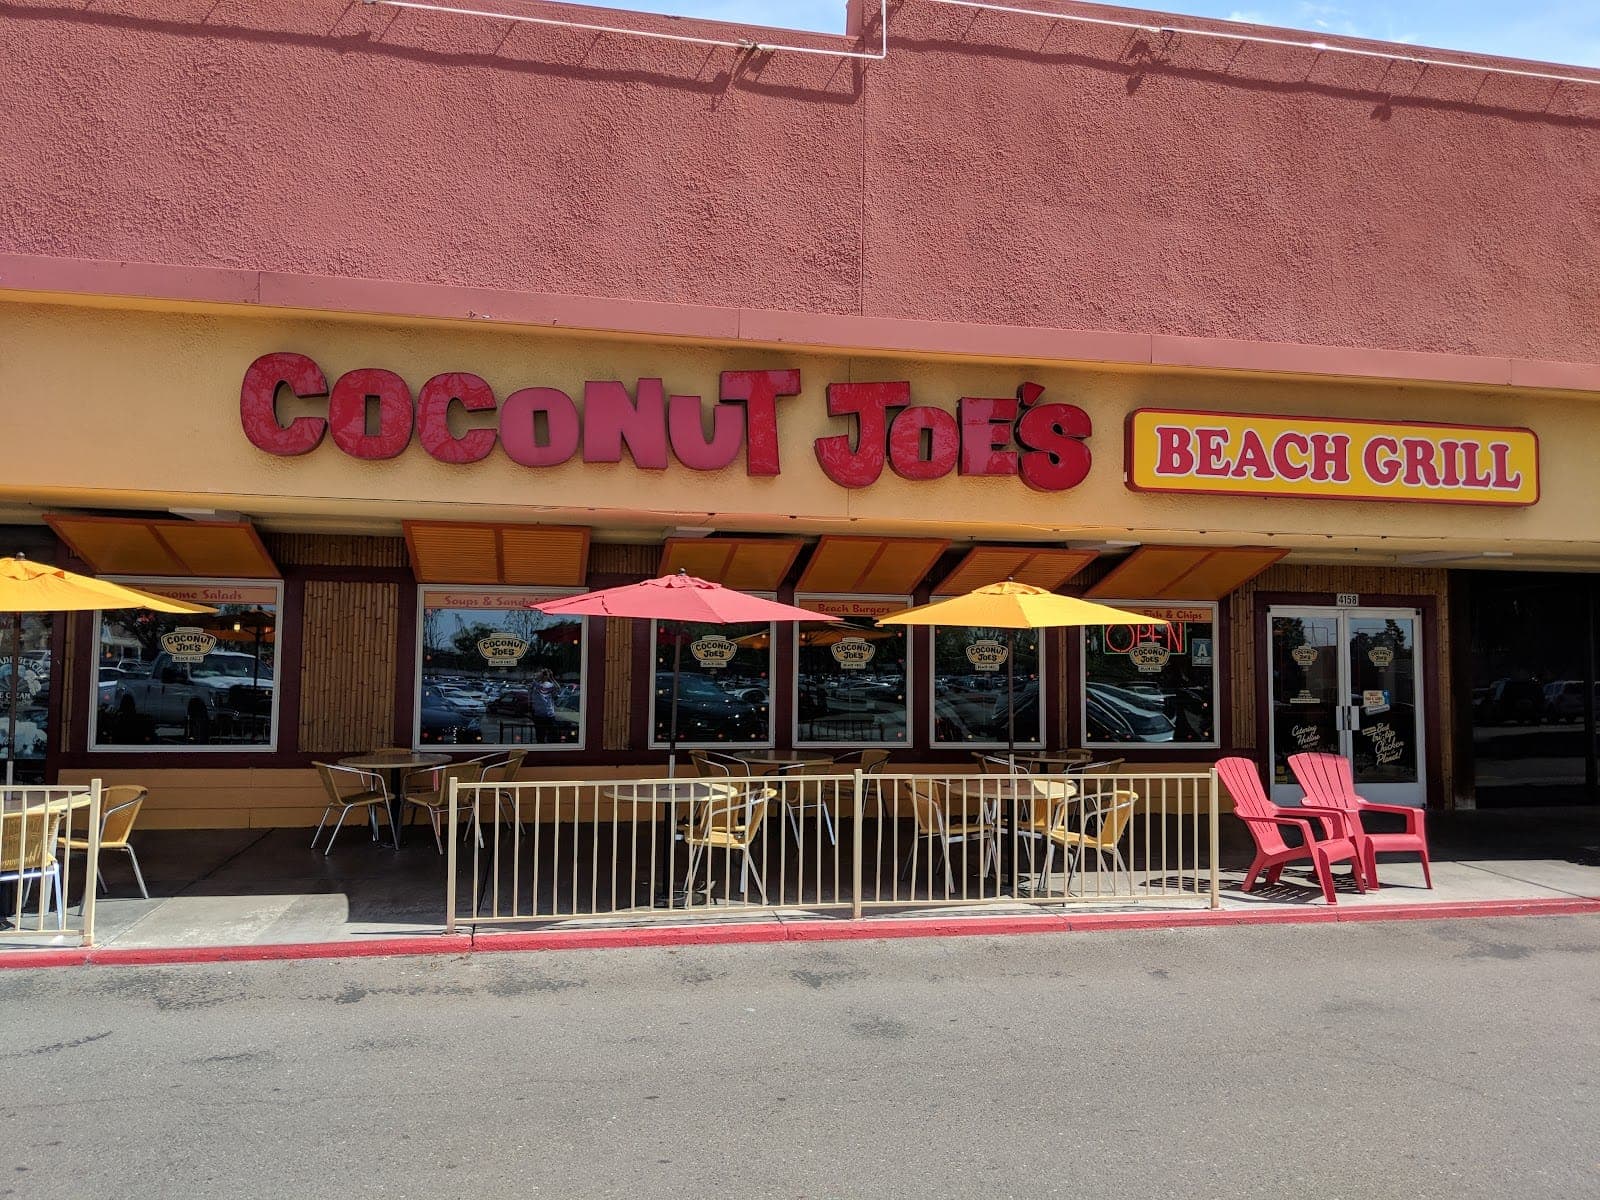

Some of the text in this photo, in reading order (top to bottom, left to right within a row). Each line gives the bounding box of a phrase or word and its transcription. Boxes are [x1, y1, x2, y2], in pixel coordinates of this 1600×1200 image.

[240, 352, 1091, 490] COCONUT JOE'S
[1155, 426, 1523, 490] BEACH GRILL
[203, 589, 242, 600] Salads
[1338, 595, 1357, 605] 4158
[444, 596, 478, 608] Soups
[483, 597, 492, 606] &
[818, 603, 890, 615] Beach Burgers
[1166, 610, 1173, 619] &
[1176, 610, 1202, 621] Chips
[167, 635, 214, 645] COCONUT
[1106, 620, 1183, 654] OPEN
[483, 639, 525, 650] COCONUT
[695, 642, 734, 652] COCONUT
[835, 644, 873, 654] COCONUT
[1197, 643, 1208, 657] A
[970, 646, 1006, 656] COCONUT
[1133, 646, 1167, 657] COCONUT
[5, 691, 31, 699] CEAM
